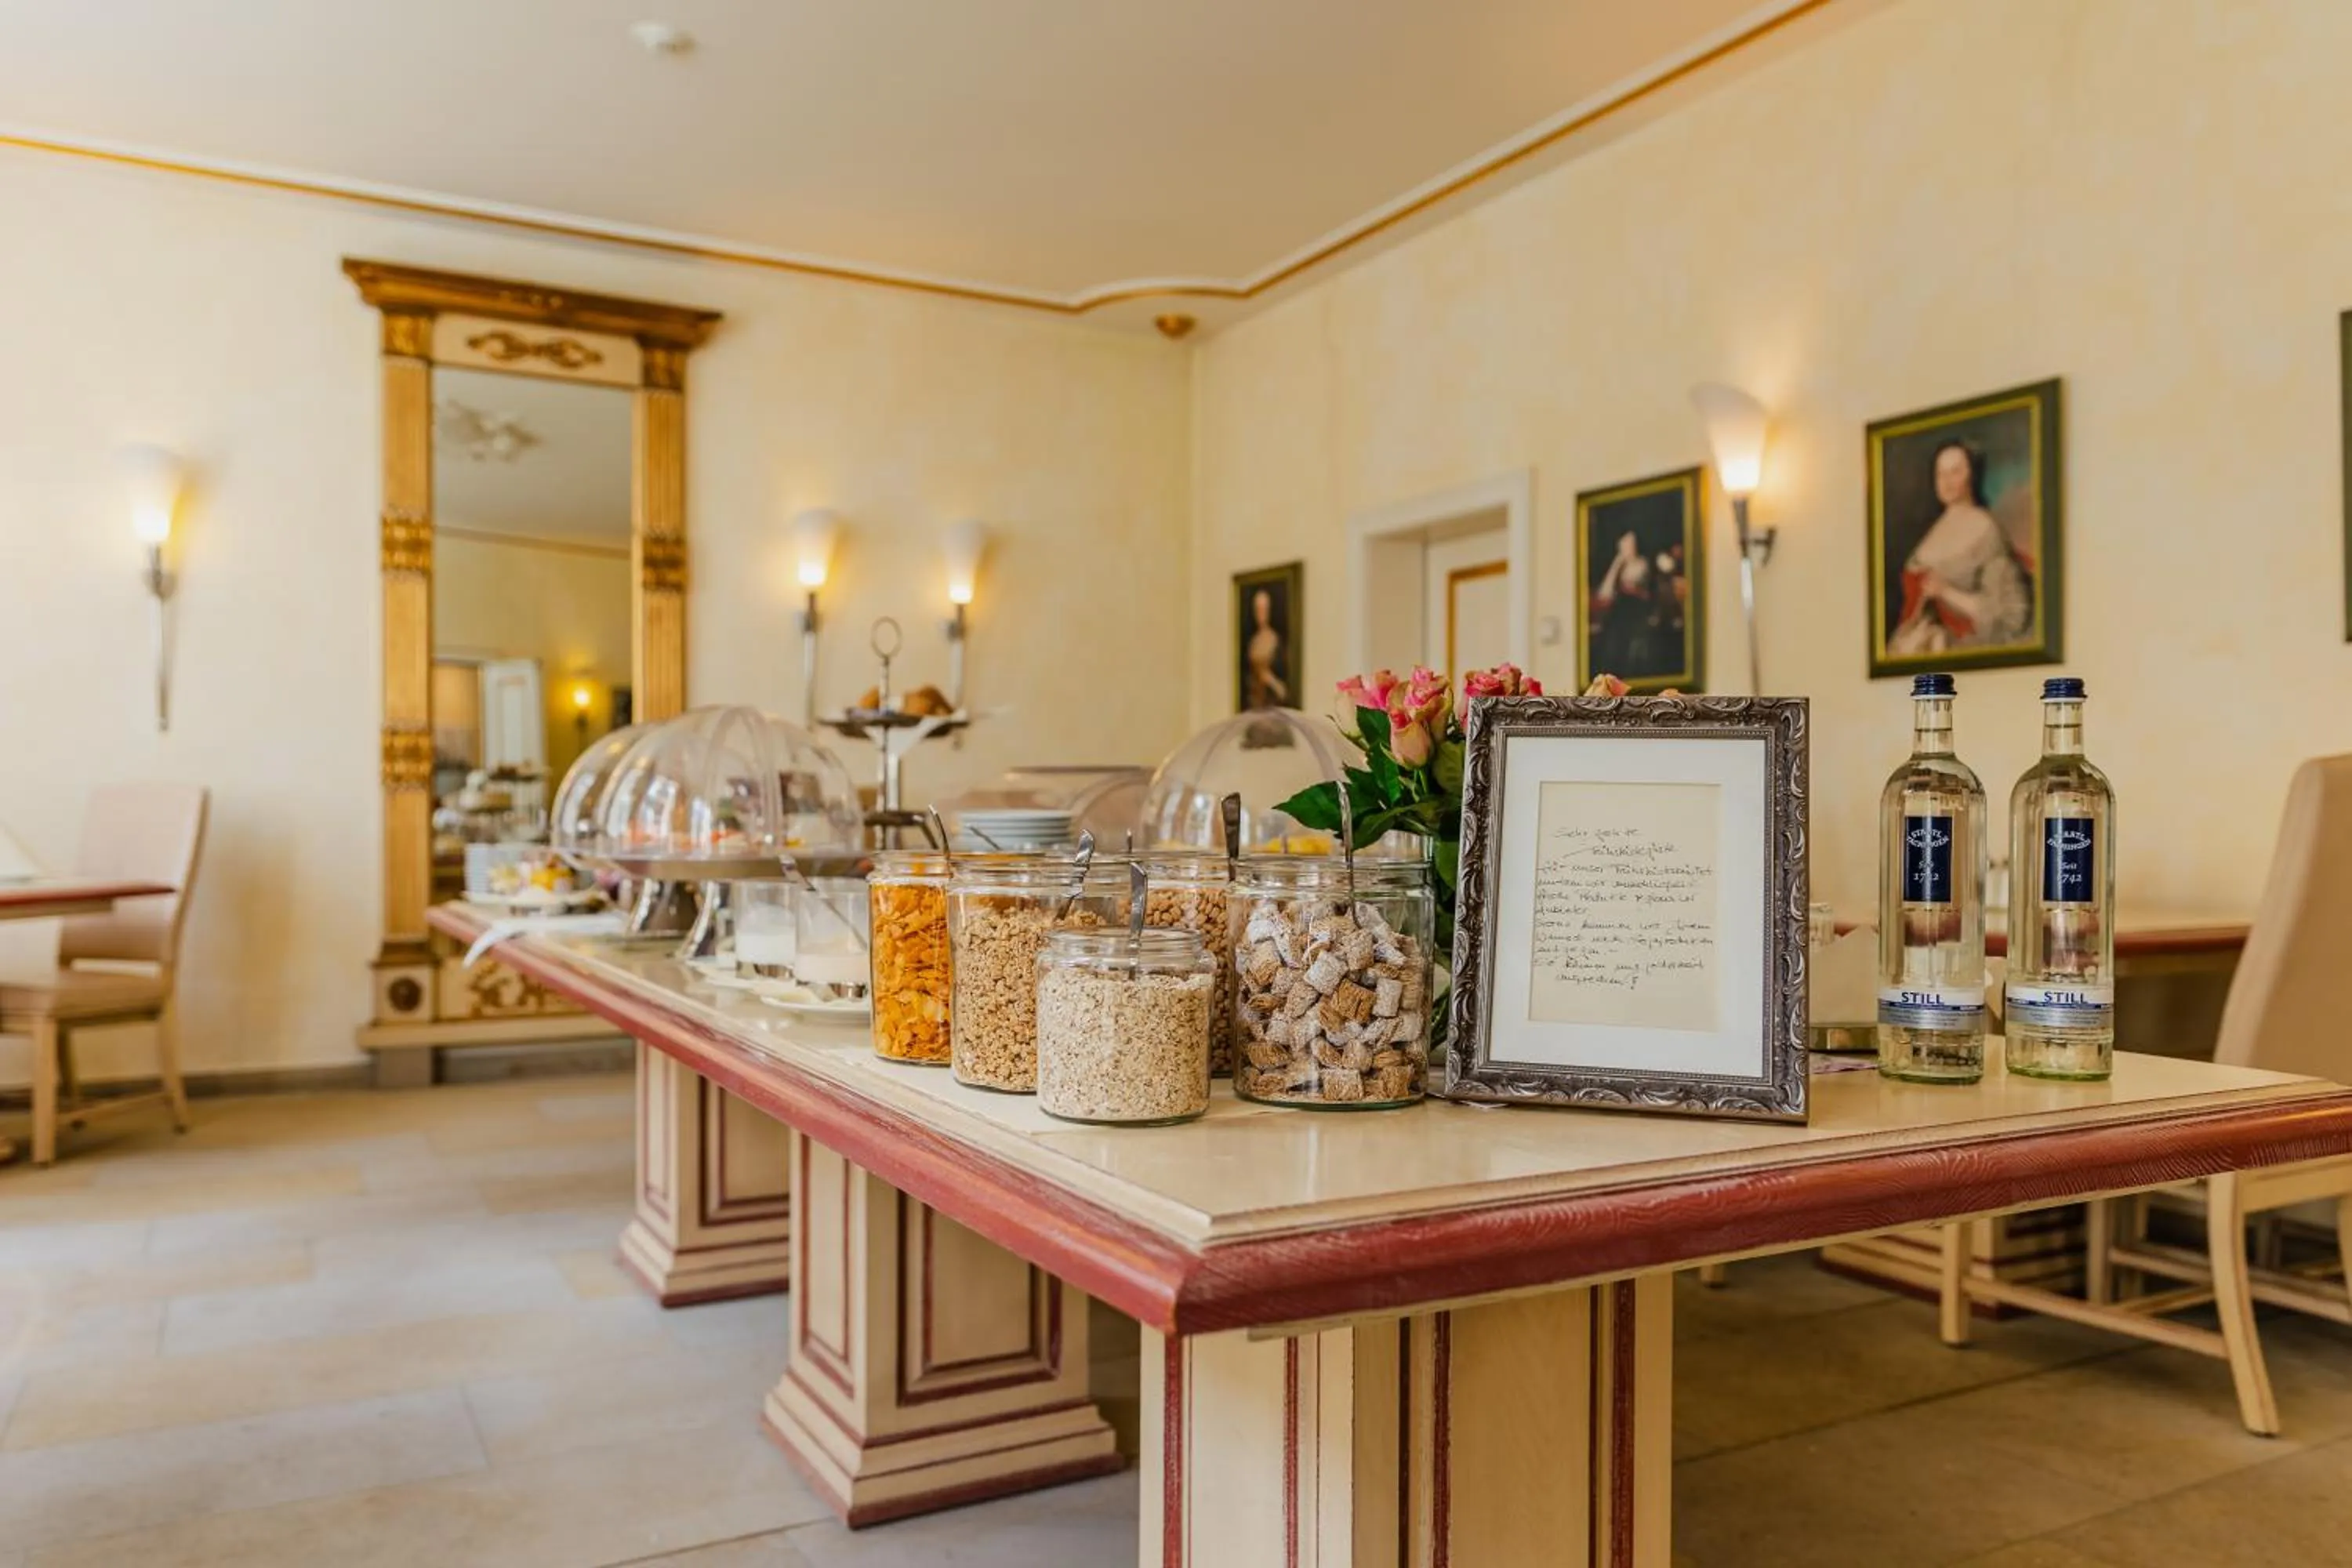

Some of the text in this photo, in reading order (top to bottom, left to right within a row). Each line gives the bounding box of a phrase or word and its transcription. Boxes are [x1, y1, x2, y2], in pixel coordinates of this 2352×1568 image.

[1914, 873, 1939, 883] 172
[2058, 874, 2082, 884] 742
[1901, 992, 1944, 1004] STILL
[2044, 992, 2088, 1004] STILL
